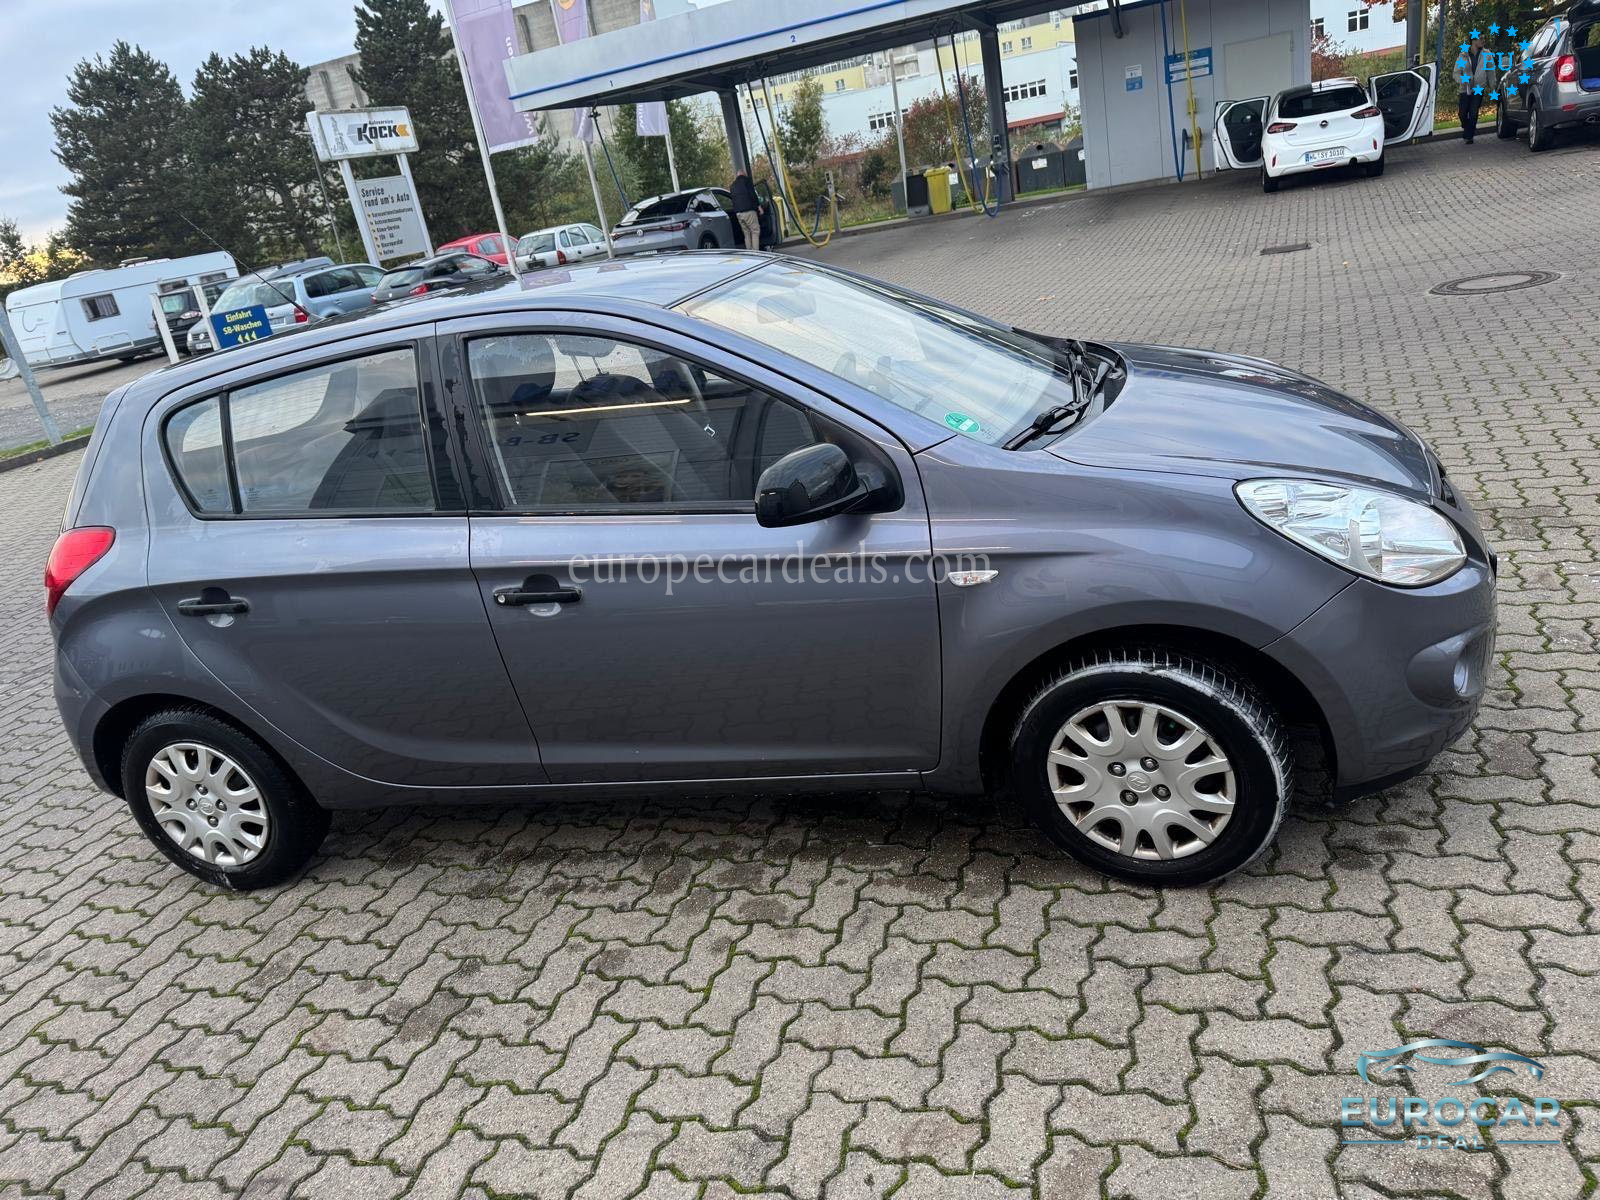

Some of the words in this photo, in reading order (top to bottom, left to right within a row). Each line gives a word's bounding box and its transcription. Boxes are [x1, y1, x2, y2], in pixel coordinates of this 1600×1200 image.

[790, 34, 796, 43] 2
[357, 123, 400, 144] KOCK
[361, 187, 385, 198] Service
[364, 197, 379, 208] rund
[381, 194, 395, 205] um's
[396, 192, 410, 203] Auto
[226, 311, 252, 322] Einfahrt
[223, 321, 262, 334] SB-Waschen
